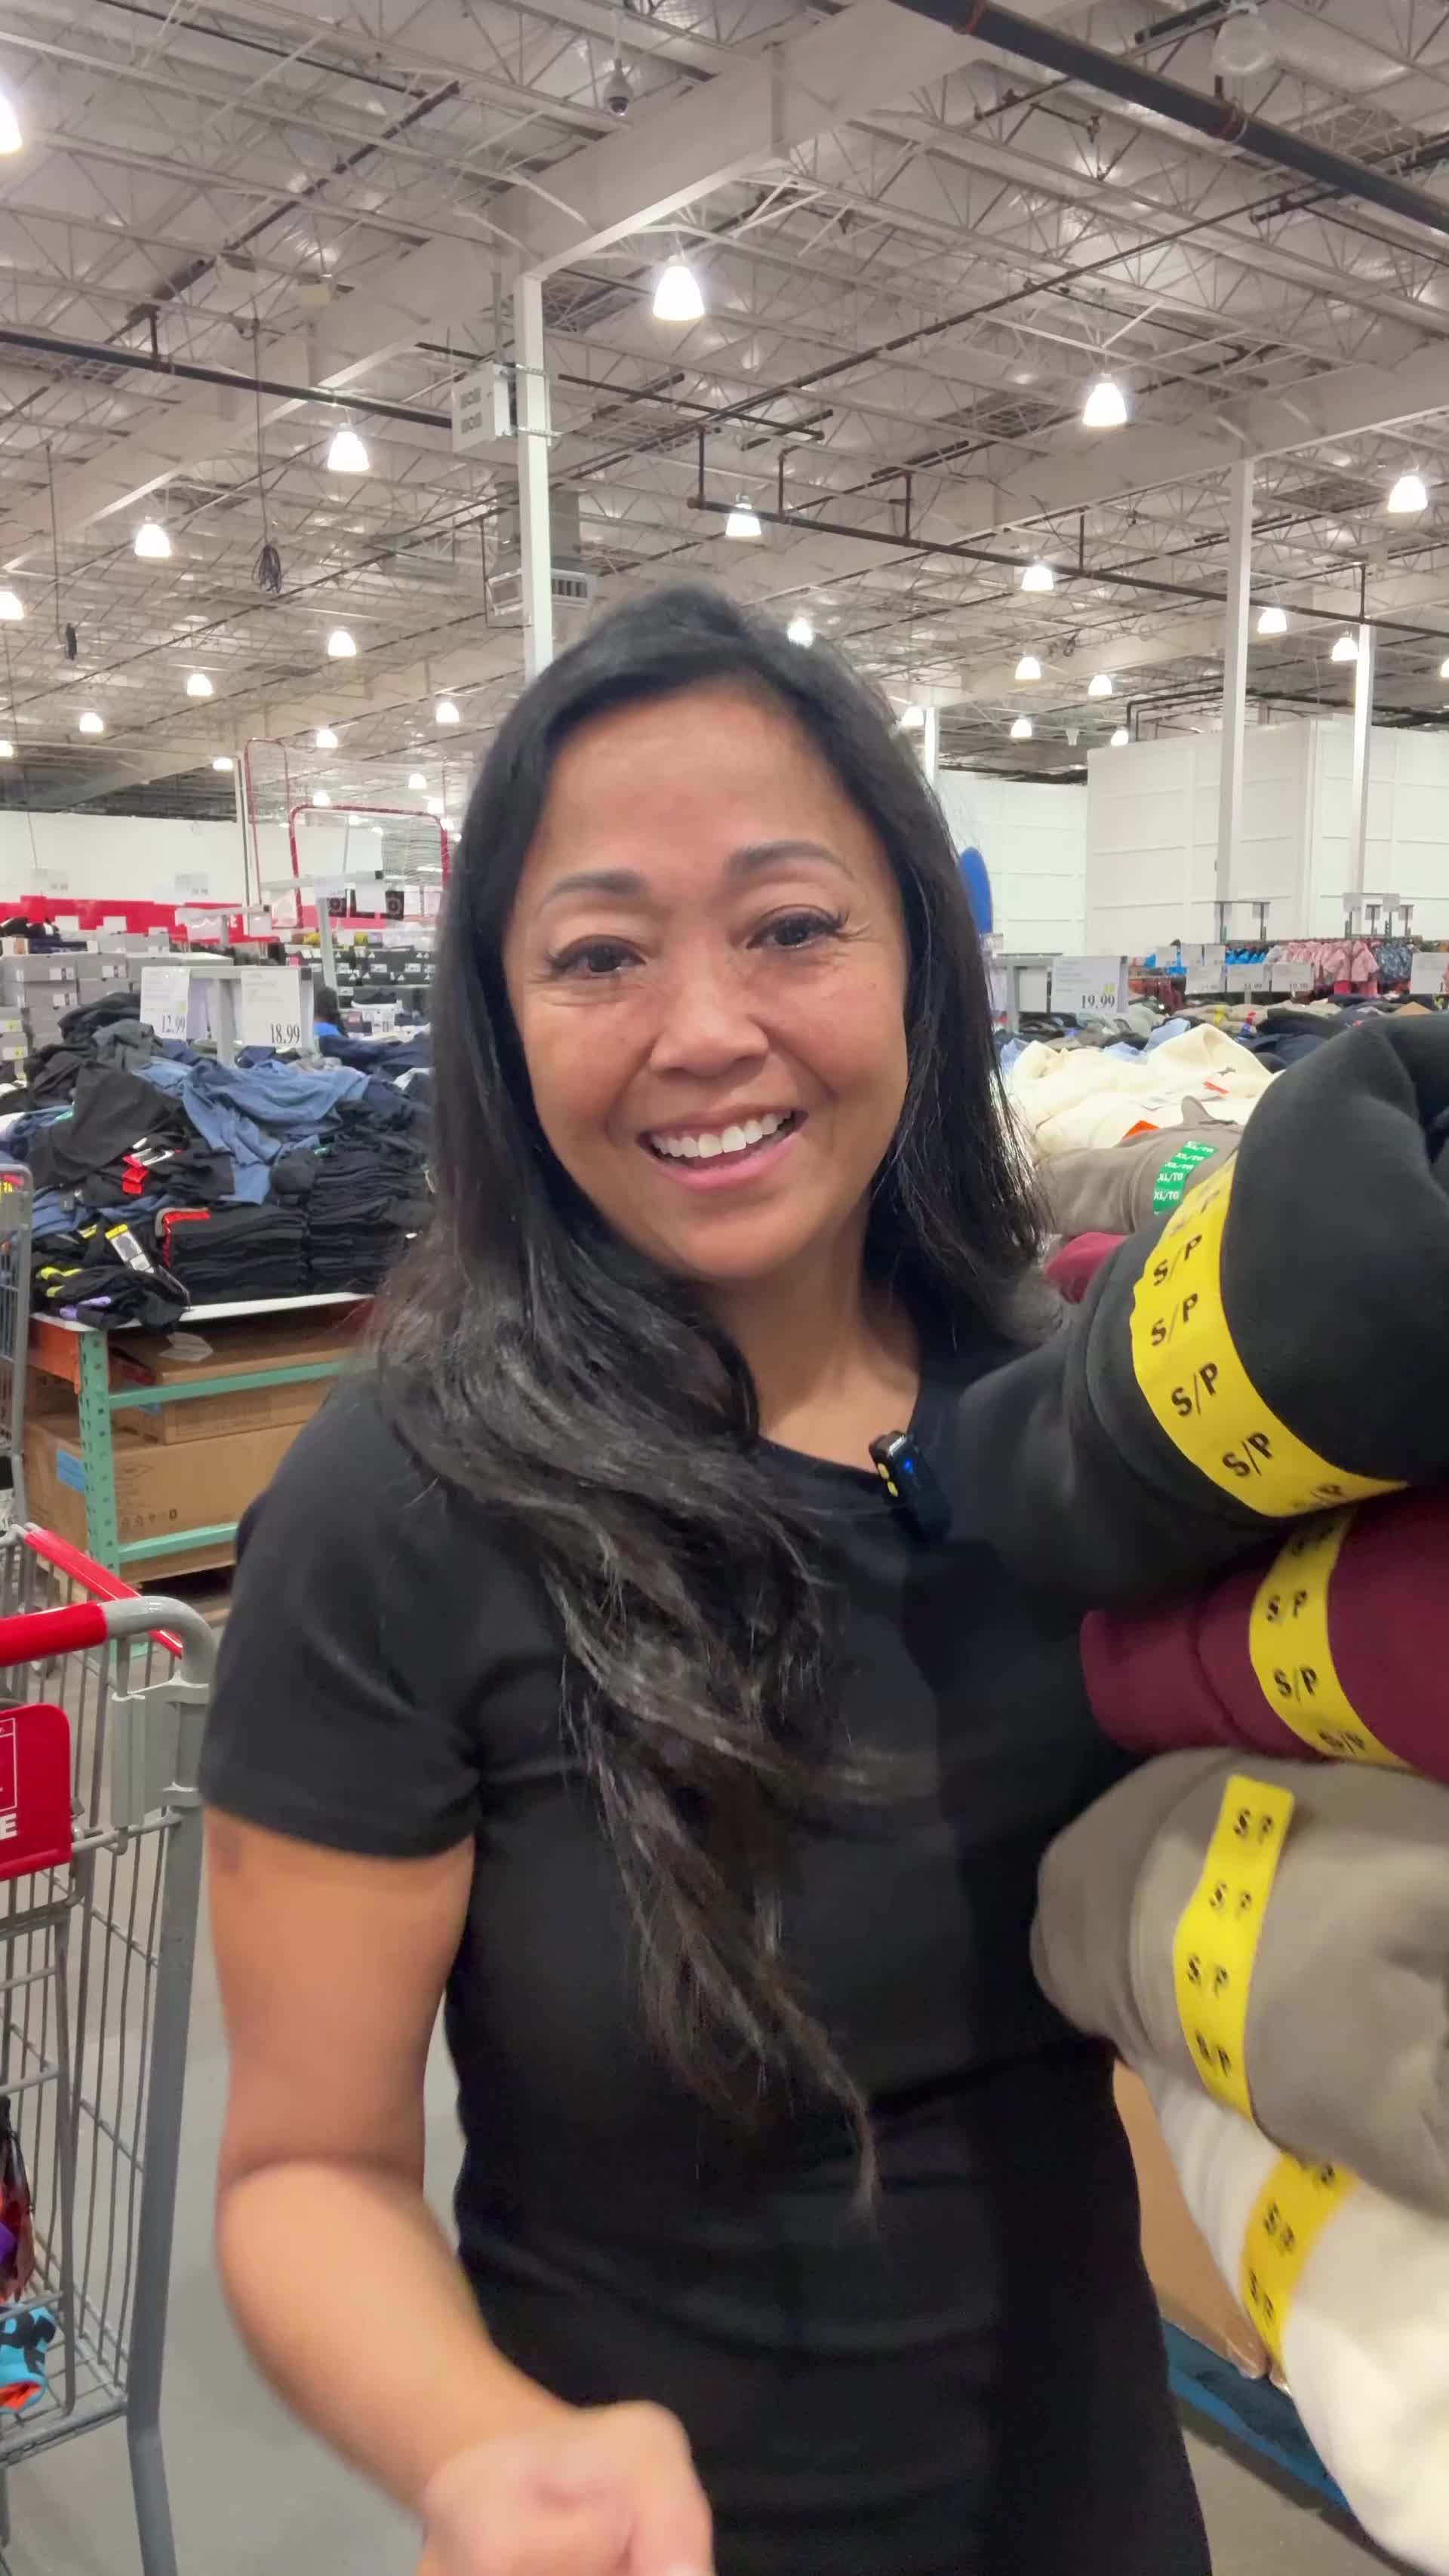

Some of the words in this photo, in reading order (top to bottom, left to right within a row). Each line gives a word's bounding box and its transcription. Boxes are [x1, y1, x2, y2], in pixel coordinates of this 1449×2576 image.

[1081, 994, 1115, 1010] 19.99
[162, 1014, 186, 1034] 12.99
[269, 1022, 300, 1045] 18.99
[1153, 1234, 1203, 1286] S/P
[1150, 1292, 1198, 1346] S/P
[1171, 1362, 1218, 1417] S/P
[1221, 1431, 1273, 1477] S/P
[1273, 1665, 1318, 1703] S/P
